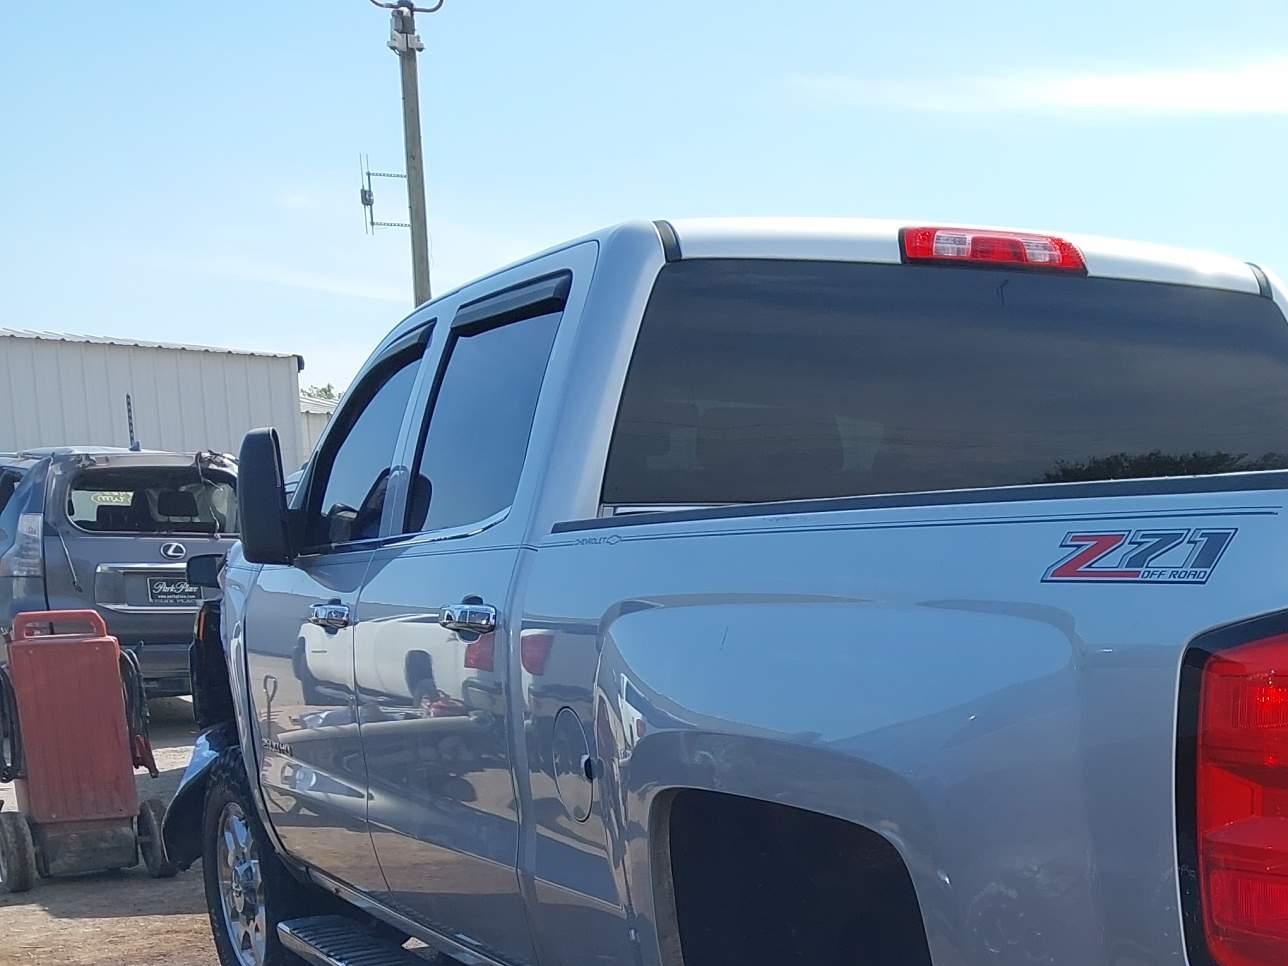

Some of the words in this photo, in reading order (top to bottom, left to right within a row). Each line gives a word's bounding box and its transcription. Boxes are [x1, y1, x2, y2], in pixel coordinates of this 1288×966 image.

[1040, 528, 1239, 584] Z71
[1141, 569, 1166, 579] OFF
[1168, 570, 1209, 580] ROAD
